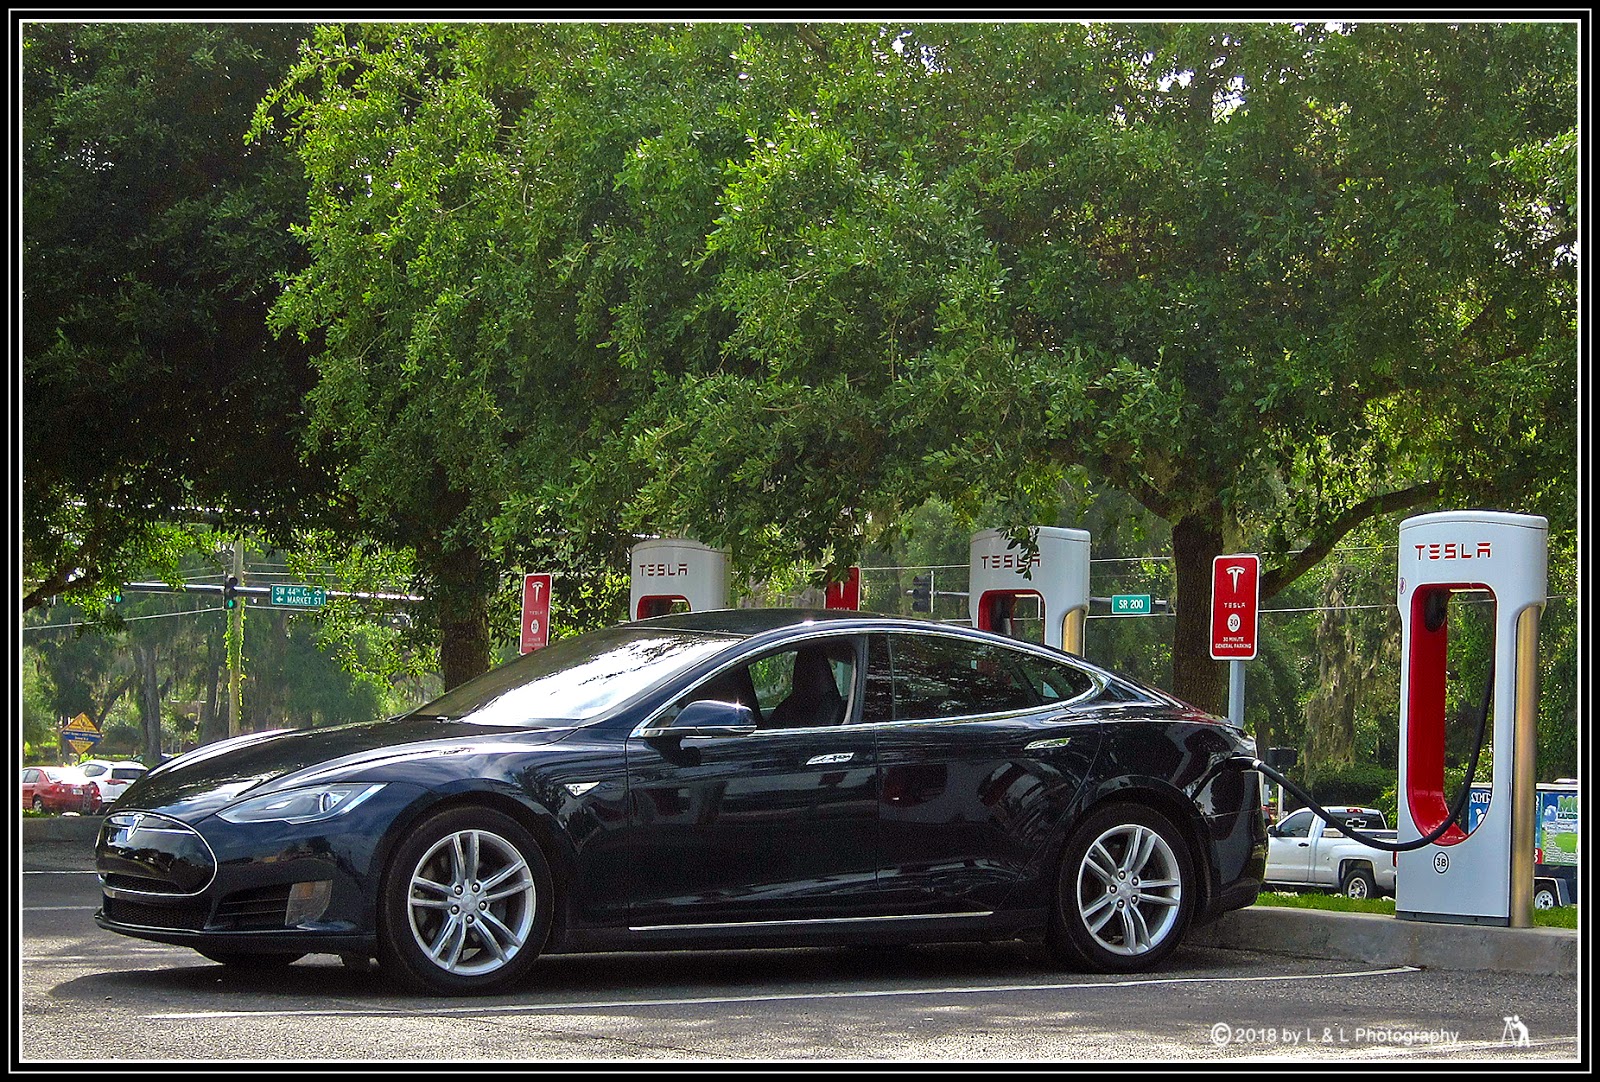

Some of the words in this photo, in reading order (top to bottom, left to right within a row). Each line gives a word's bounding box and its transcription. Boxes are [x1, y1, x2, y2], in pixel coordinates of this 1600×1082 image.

[1413, 542, 1491, 561] TESLA
[981, 553, 1041, 569] TESLA
[639, 563, 688, 577] TESLA
[275, 587, 285, 596] SW
[287, 596, 311, 605] MARKET
[313, 597, 322, 605] ST
[1118, 599, 1128, 609] SR
[1130, 599, 1144, 609] 200
[1229, 618, 1239, 627] 30
[1436, 857, 1447, 867] 3B
